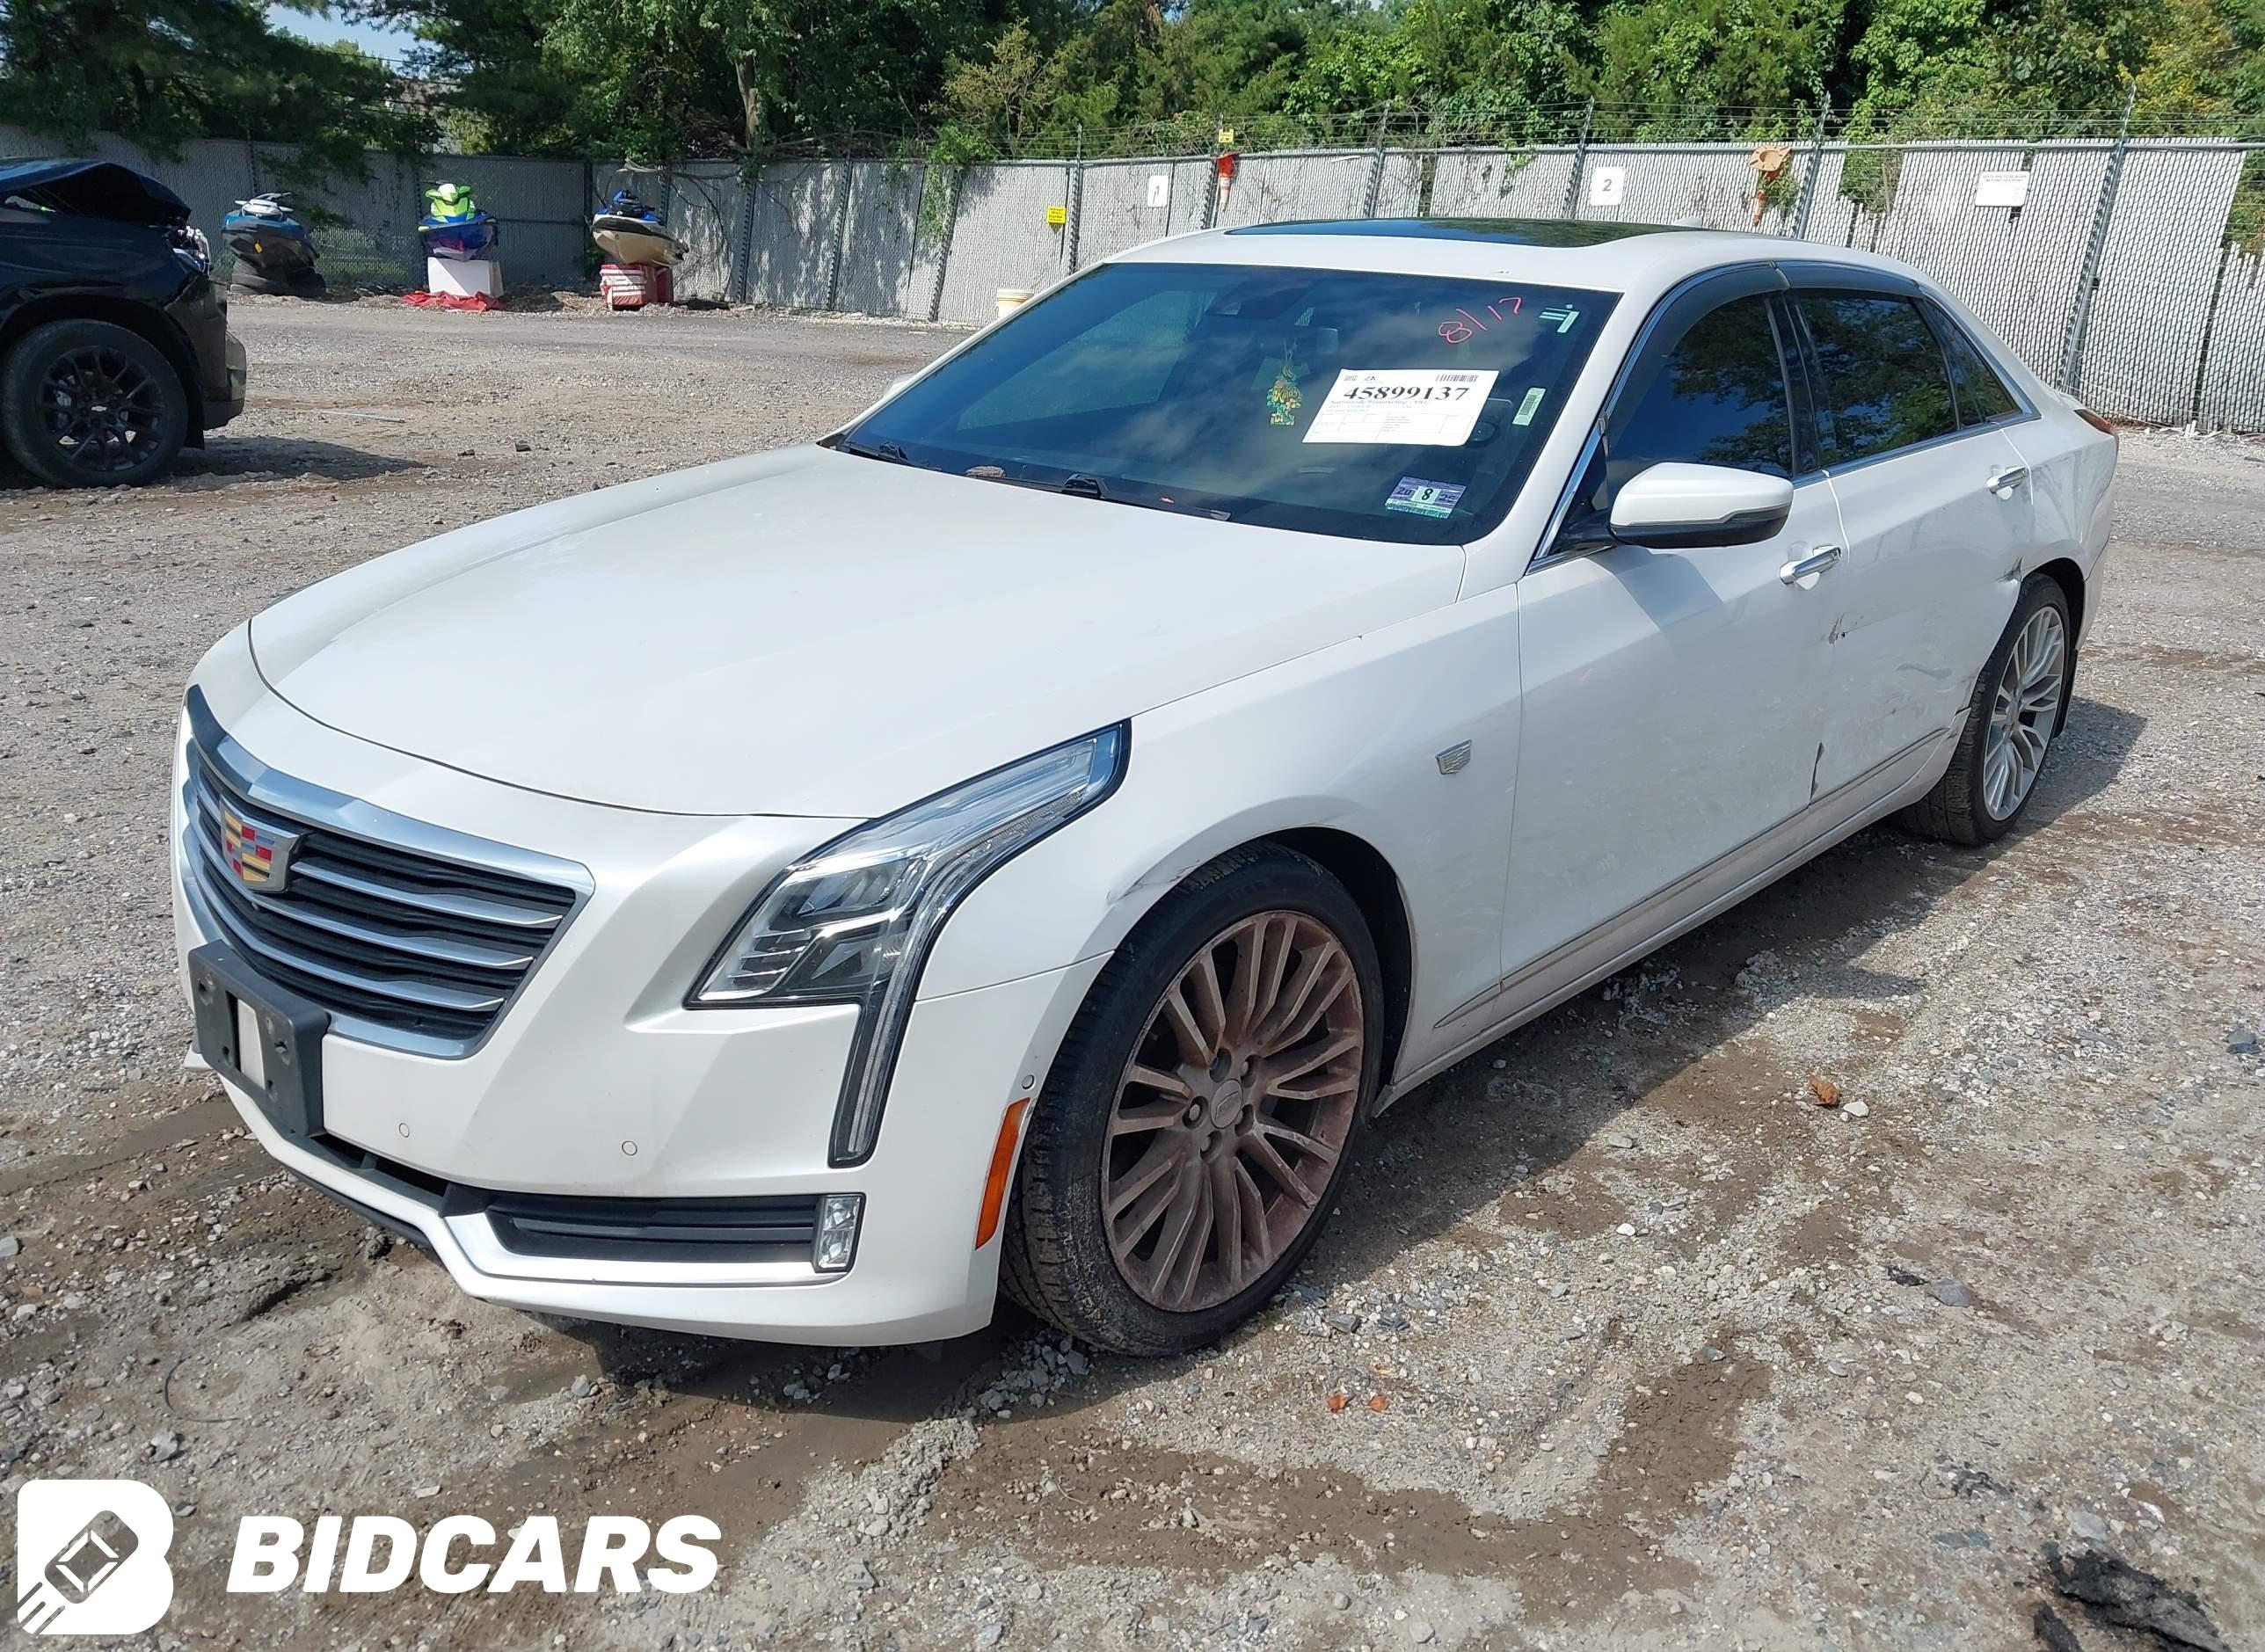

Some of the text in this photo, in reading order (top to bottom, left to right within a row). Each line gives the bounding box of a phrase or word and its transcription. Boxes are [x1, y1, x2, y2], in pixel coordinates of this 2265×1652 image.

[1602, 178, 1613, 192] 2
[1438, 296, 1522, 344] 8/17
[1344, 386, 1471, 402] 45899137
[1421, 488, 1434, 501] 8
